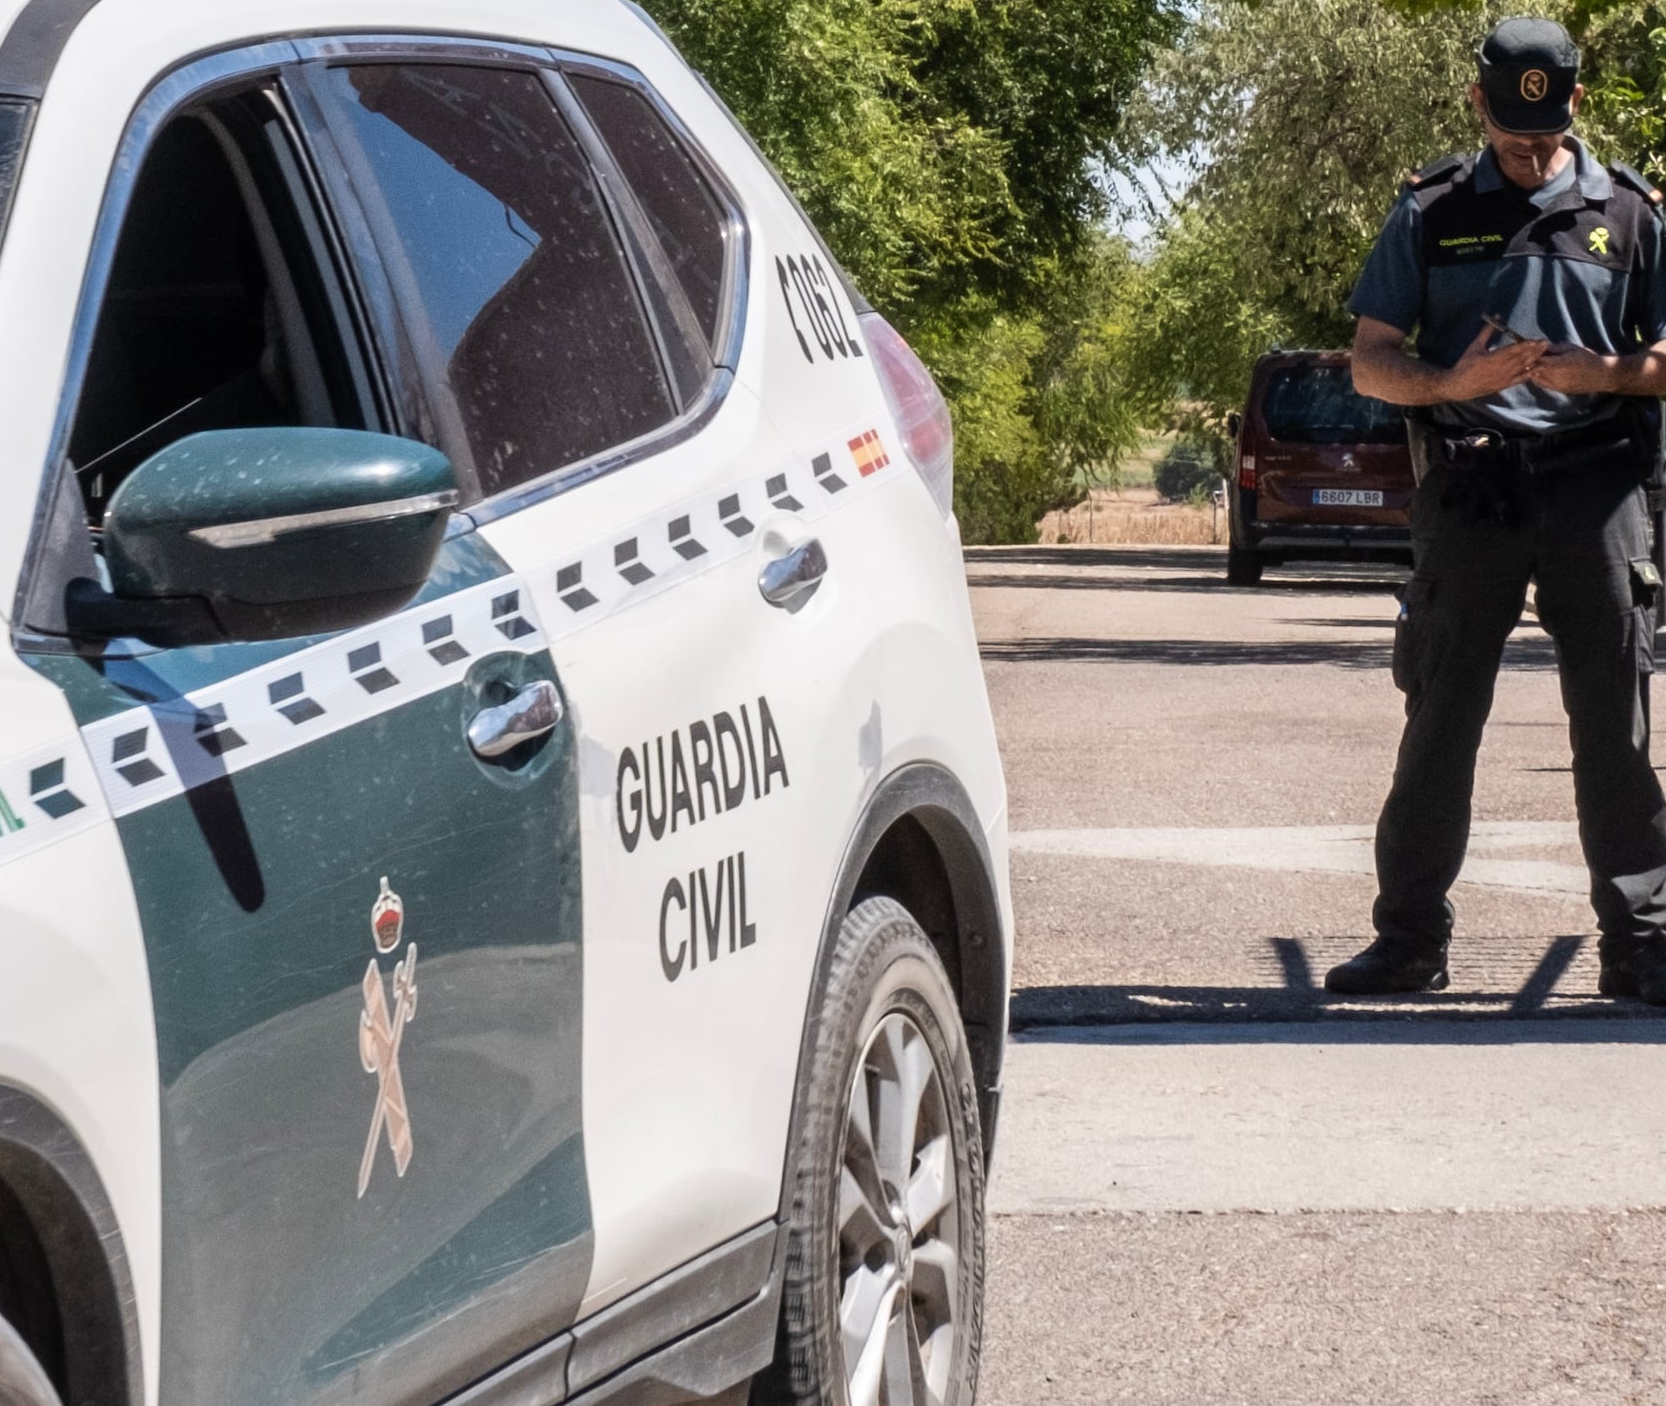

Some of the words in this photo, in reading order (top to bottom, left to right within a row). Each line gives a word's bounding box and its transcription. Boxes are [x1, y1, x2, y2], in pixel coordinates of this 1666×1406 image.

[1439, 237, 1479, 246] GUARDIA
[1321, 491, 1352, 503] 6607
[1356, 492, 1380, 504] LBR
[617, 695, 790, 854] GUARDIA
[658, 851, 757, 982] CIVIL
